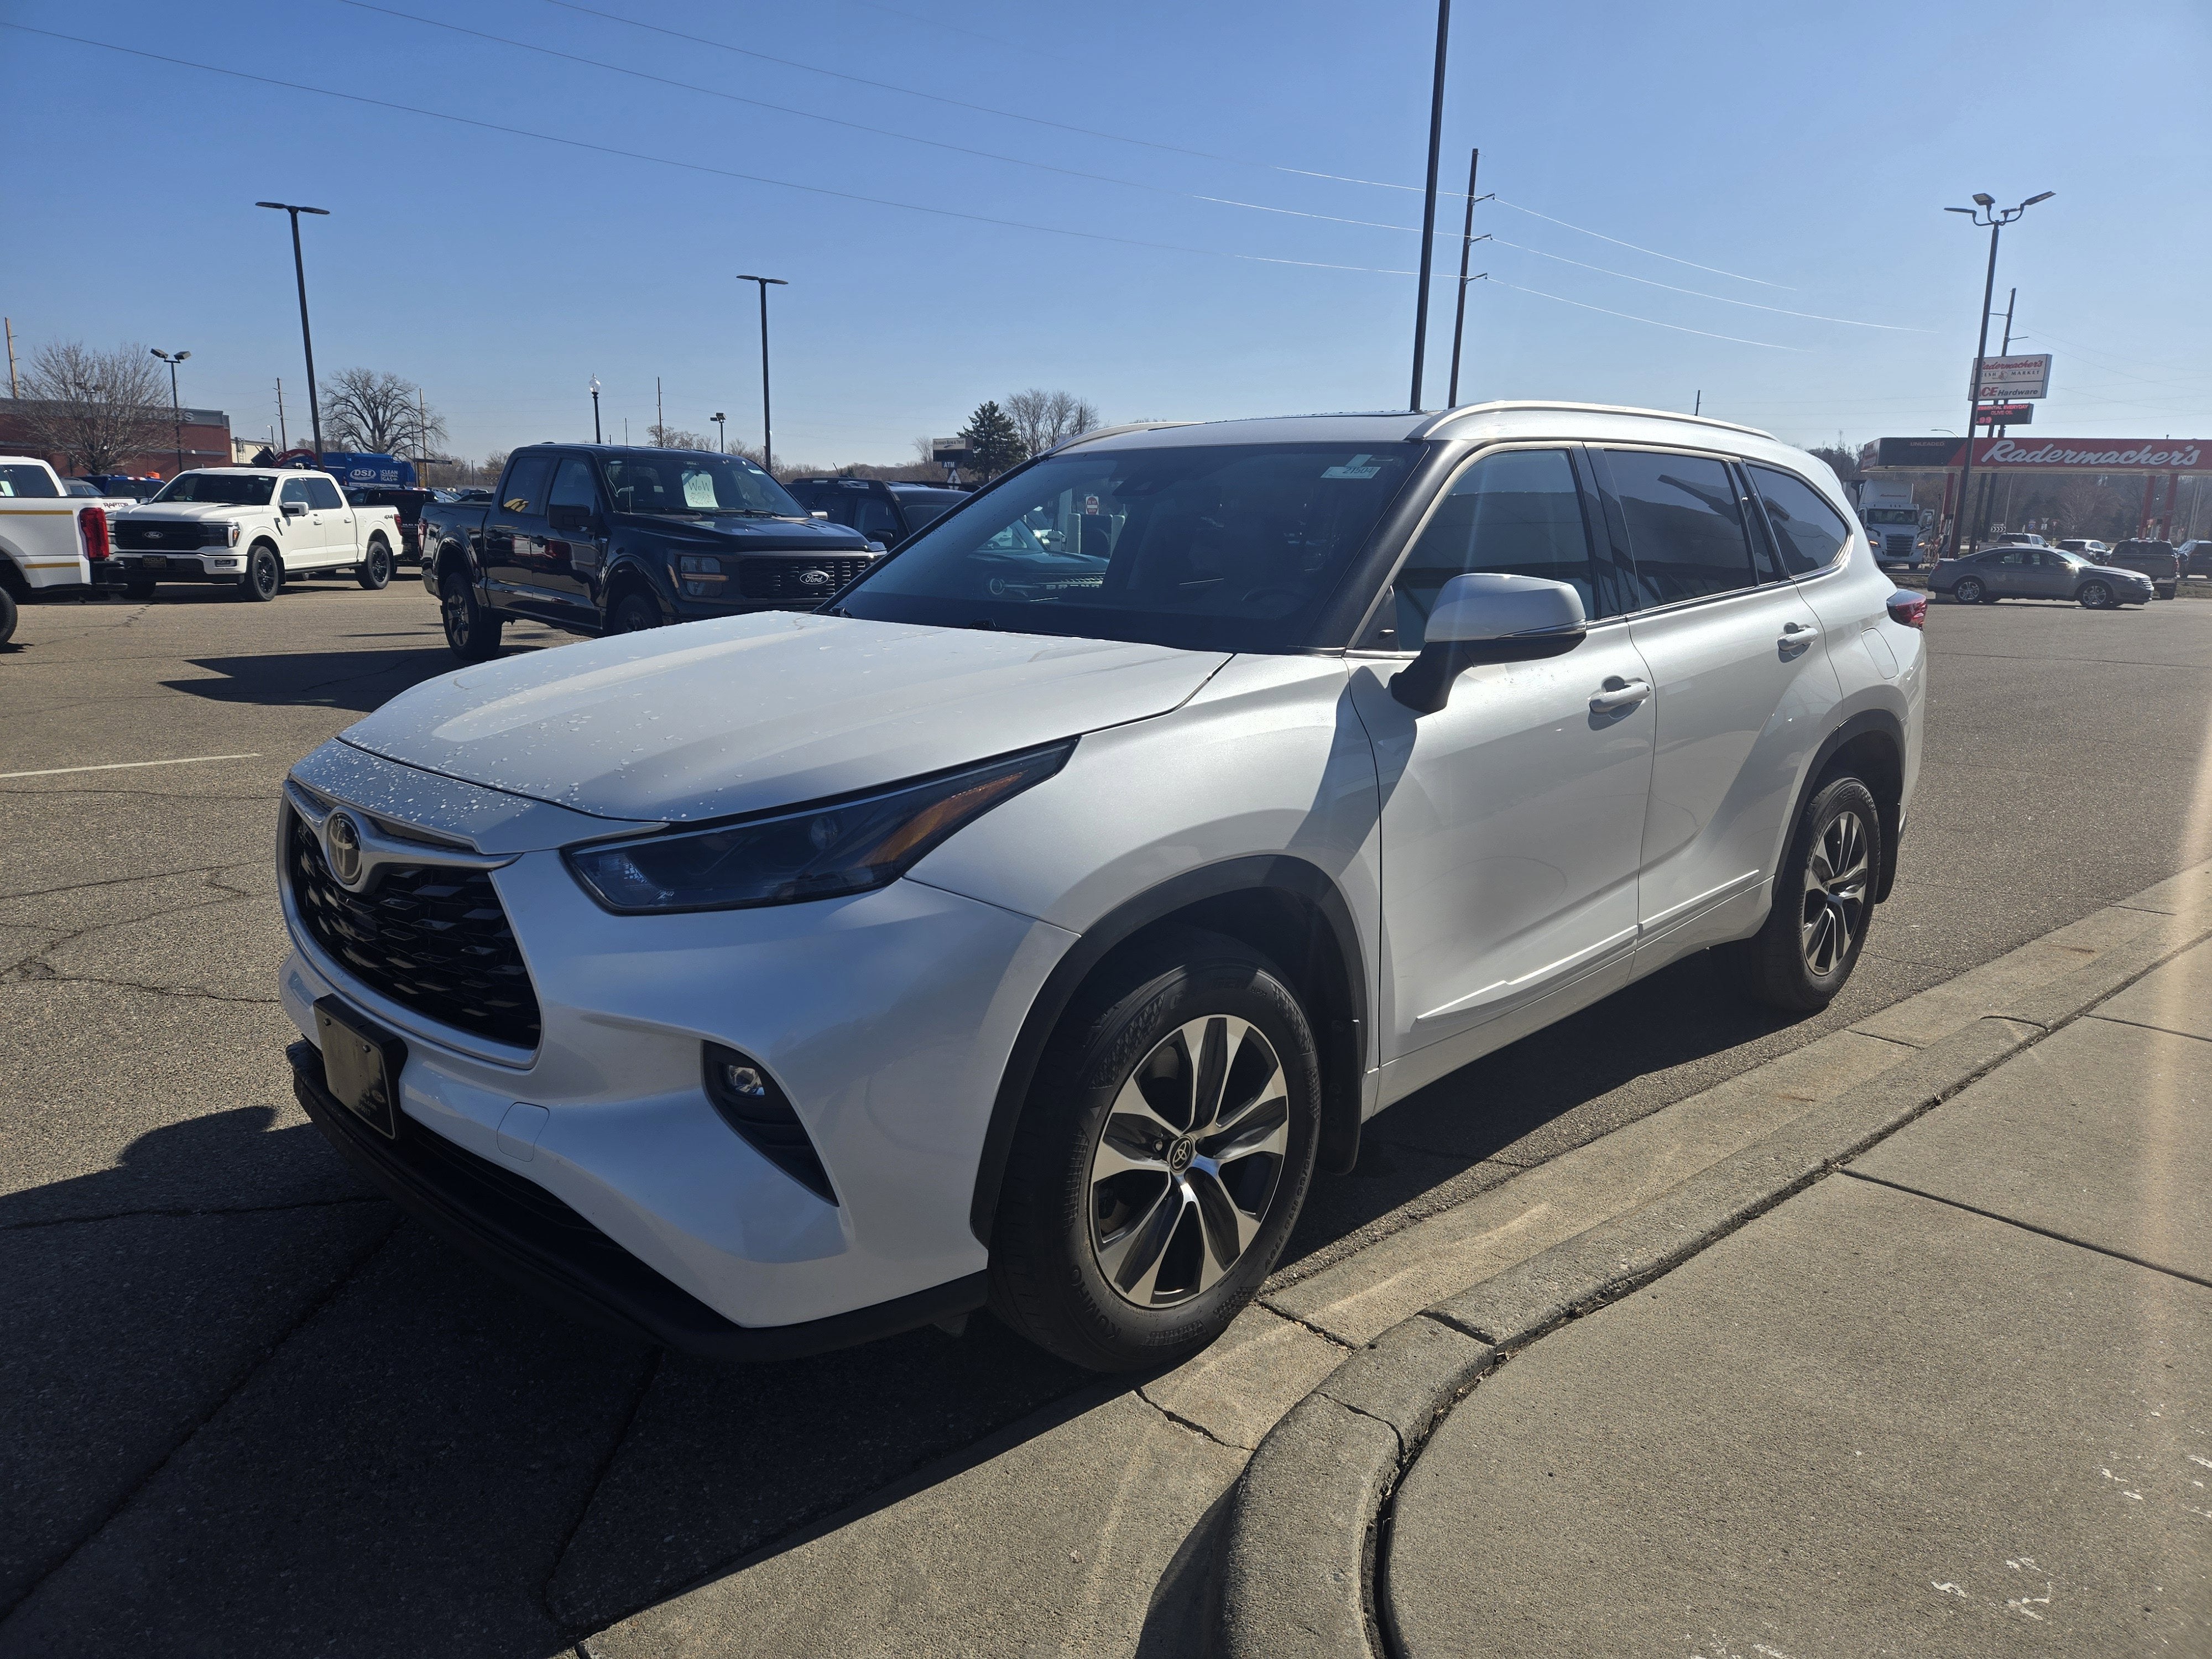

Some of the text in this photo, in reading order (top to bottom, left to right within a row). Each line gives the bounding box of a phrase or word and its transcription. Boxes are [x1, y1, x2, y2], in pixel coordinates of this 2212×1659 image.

[1981, 440, 2201, 466] Radermacher's
[805, 573, 823, 583] Ford
[1071, 1264, 1122, 1339] KUMHO
